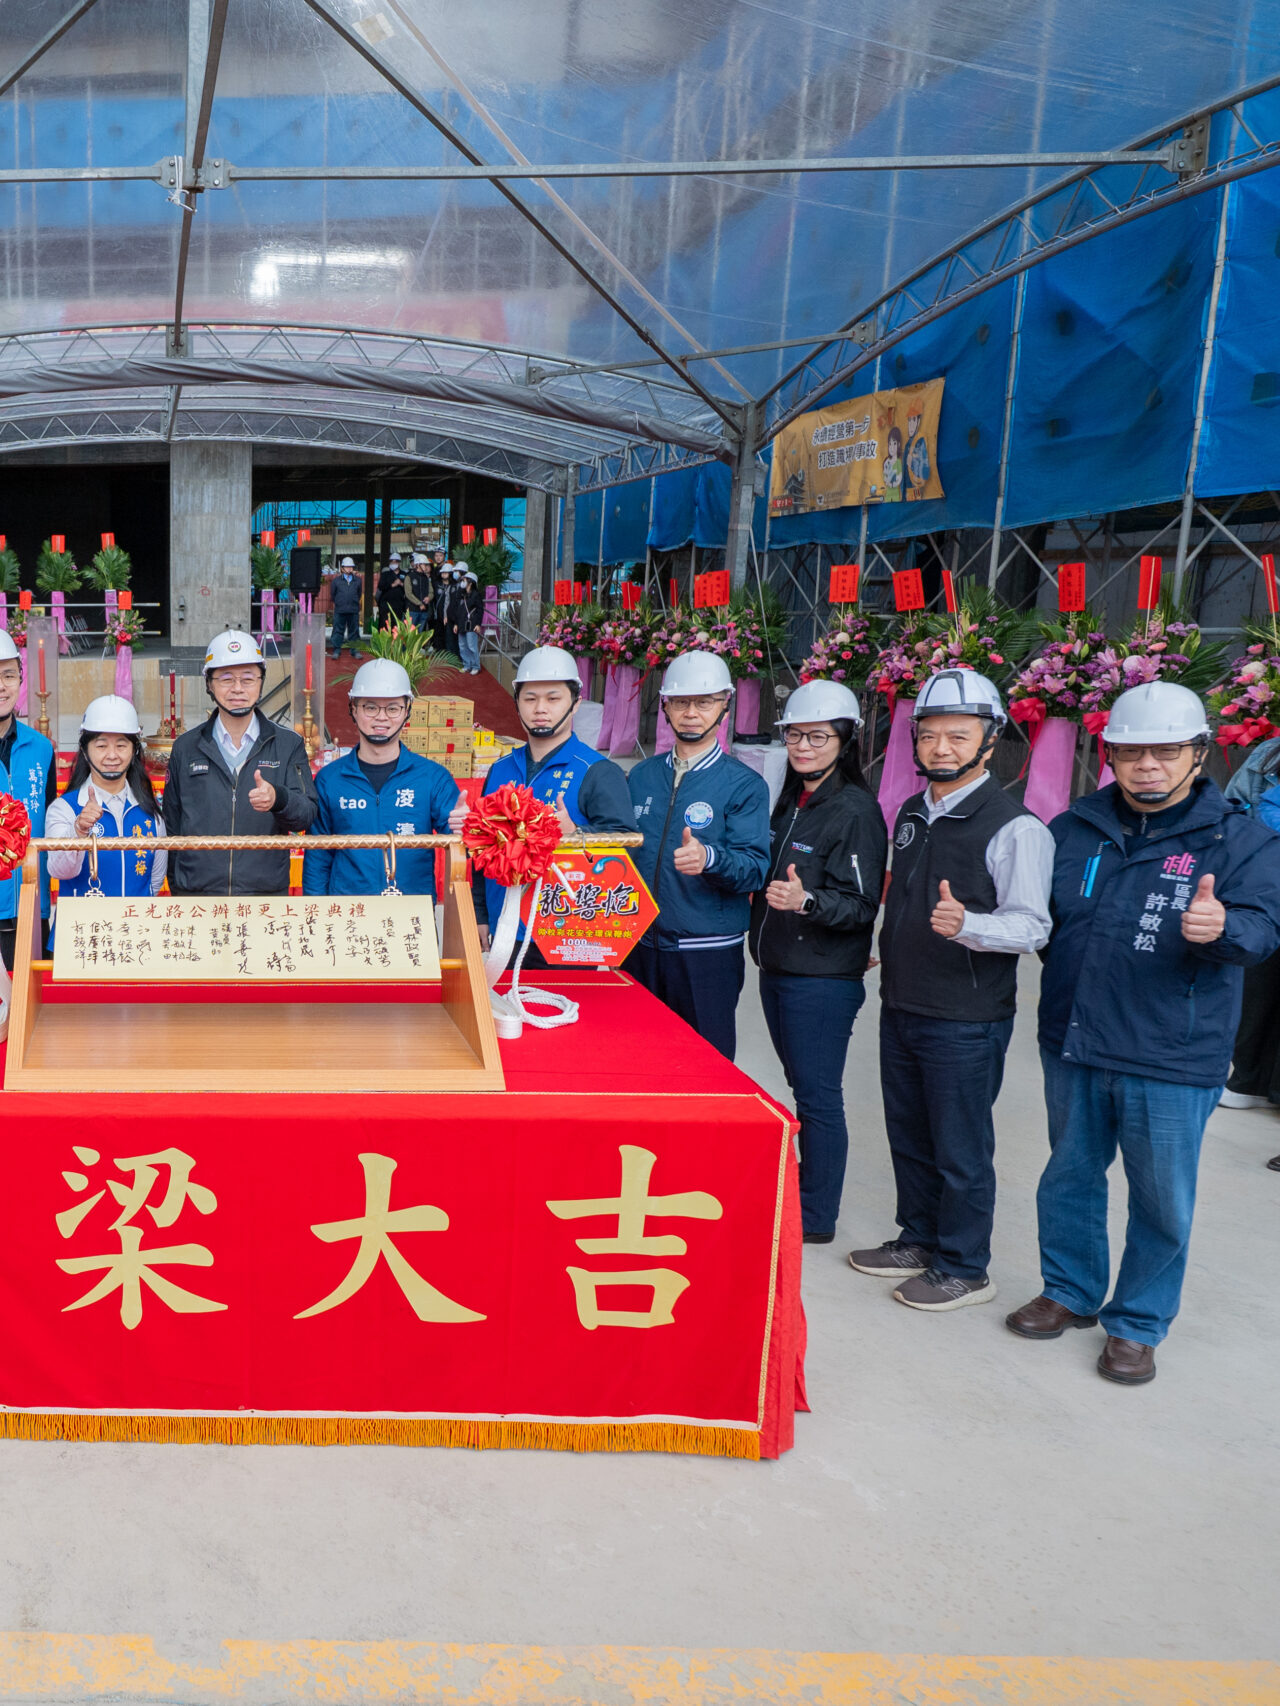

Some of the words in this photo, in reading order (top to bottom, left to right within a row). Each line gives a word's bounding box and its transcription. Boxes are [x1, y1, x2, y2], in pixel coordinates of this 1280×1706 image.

[818, 442, 877, 469] 打造職場事故
[339, 796, 367, 810] tao
[1170, 883, 1193, 911] 區長
[122, 903, 368, 919] 正光路公辦都更上梁典禮
[1132, 892, 1168, 953] 許敏松
